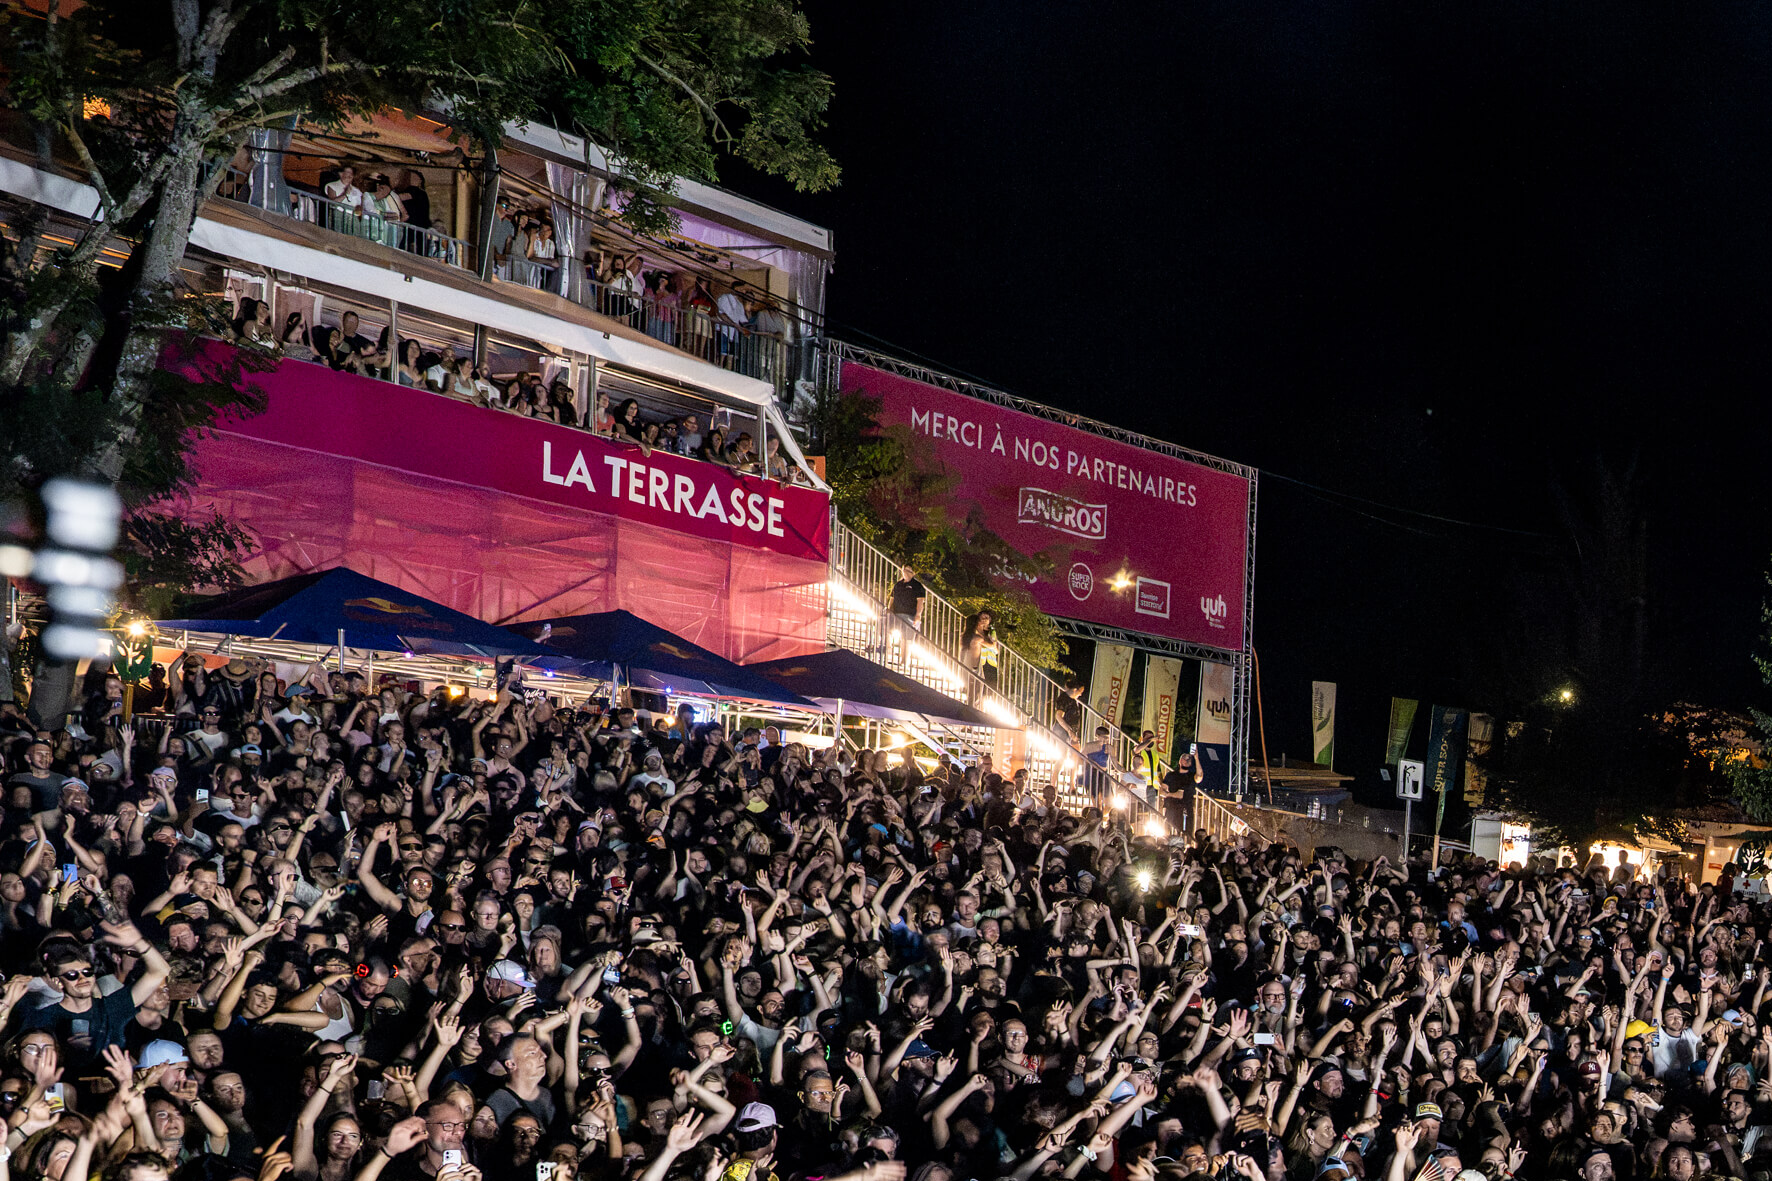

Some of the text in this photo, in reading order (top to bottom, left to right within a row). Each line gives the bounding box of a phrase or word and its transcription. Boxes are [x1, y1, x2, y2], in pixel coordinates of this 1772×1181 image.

[911, 406, 1197, 507] MERCI À NOS PARTENAIRES
[542, 440, 785, 537] LA TERRASSE
[1022, 494, 1102, 534] ANDROS
[1071, 572, 1090, 583] SUPER
[1201, 594, 1227, 621] yuh
[1105, 680, 1121, 725] NDROS
[1206, 697, 1230, 717] yuh
[1157, 697, 1171, 753] ANDROS
